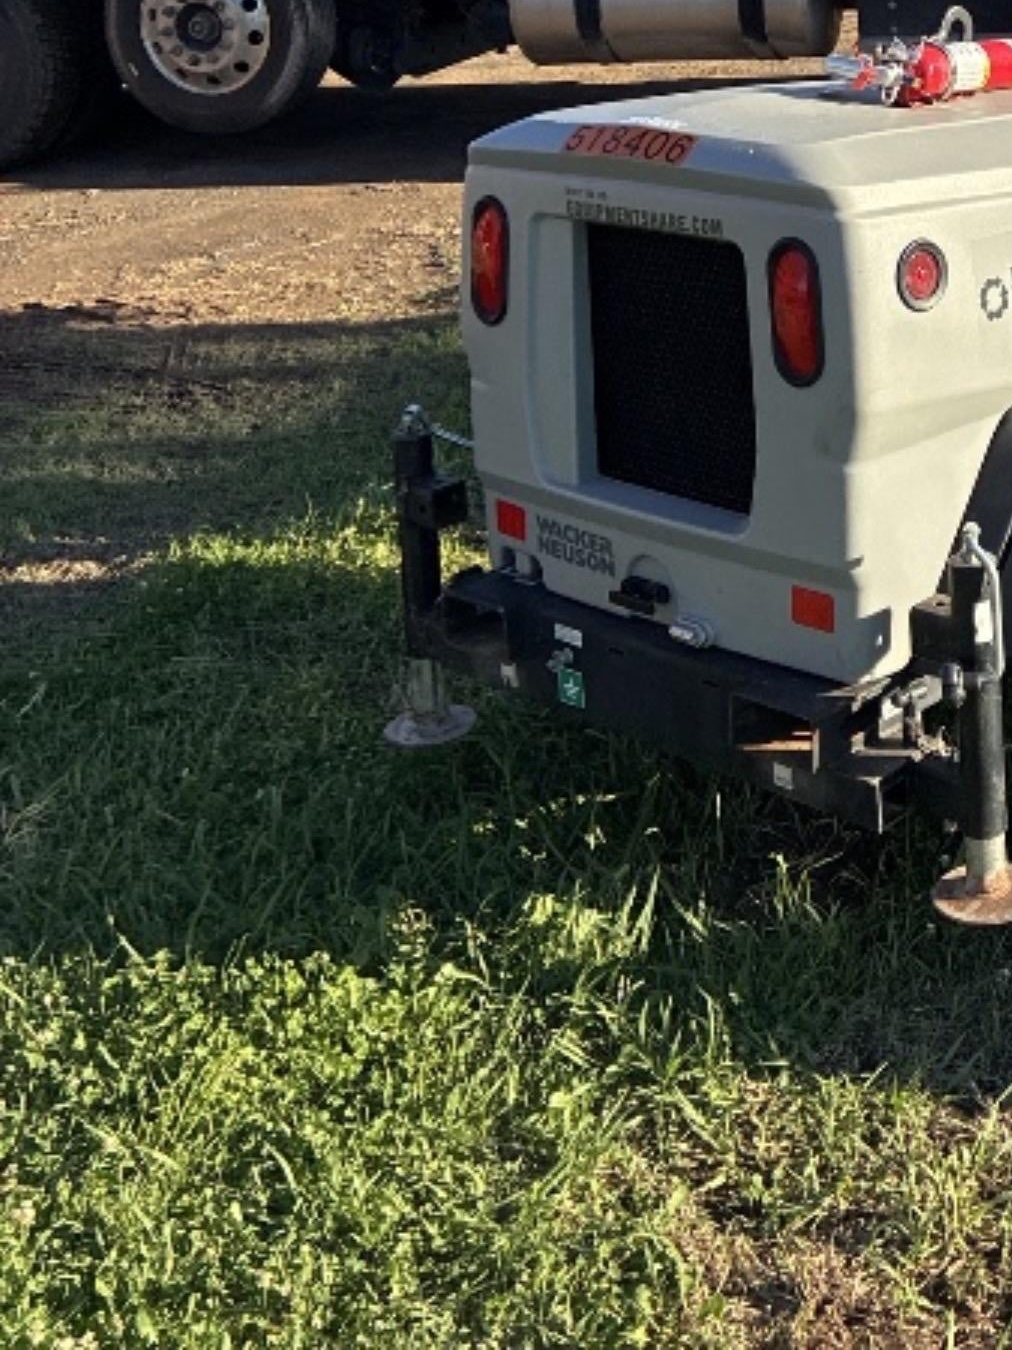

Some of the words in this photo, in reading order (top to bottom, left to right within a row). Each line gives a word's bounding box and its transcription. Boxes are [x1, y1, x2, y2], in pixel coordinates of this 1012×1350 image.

[566, 125, 694, 163] 518406
[536, 514, 613, 558] WACKER
[539, 536, 616, 579] NEUSON
